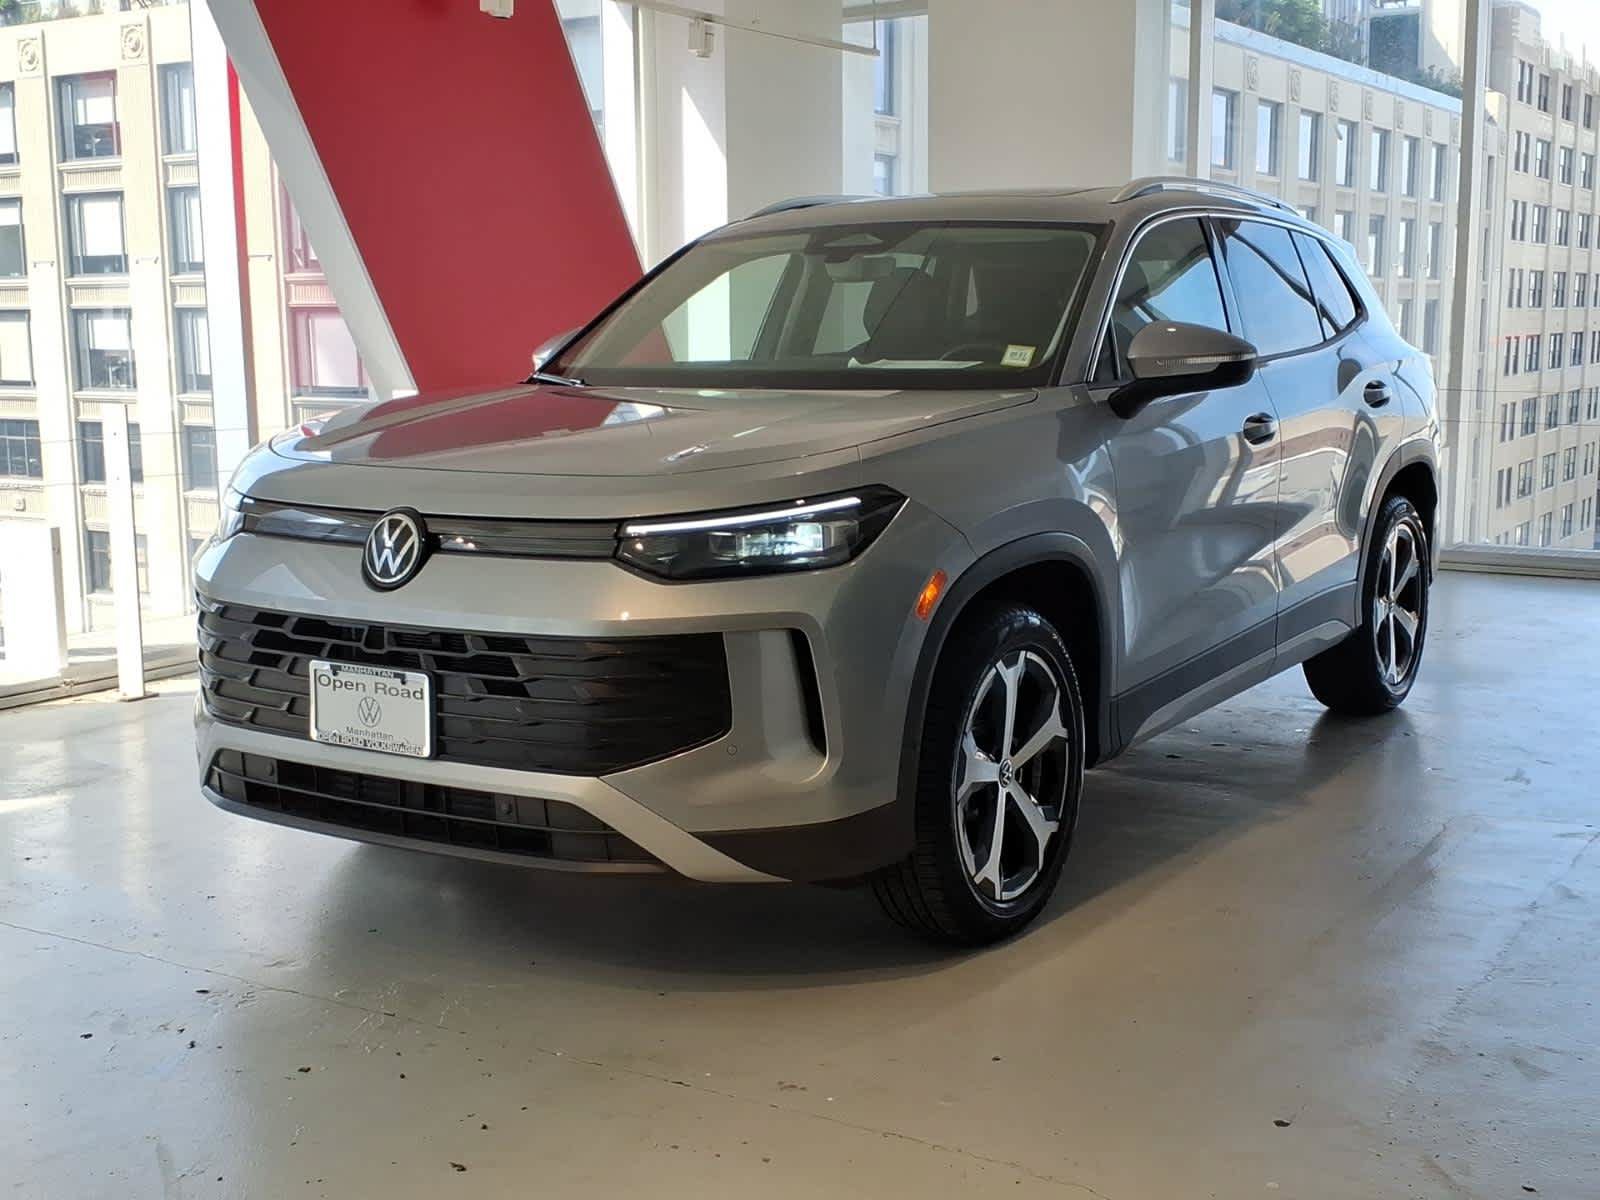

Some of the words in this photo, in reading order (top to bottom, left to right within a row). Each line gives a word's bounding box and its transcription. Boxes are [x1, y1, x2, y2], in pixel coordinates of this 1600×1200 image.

[318, 673, 366, 692] Open
[374, 681, 424, 700] Road
[346, 726, 393, 741] Manhattan
